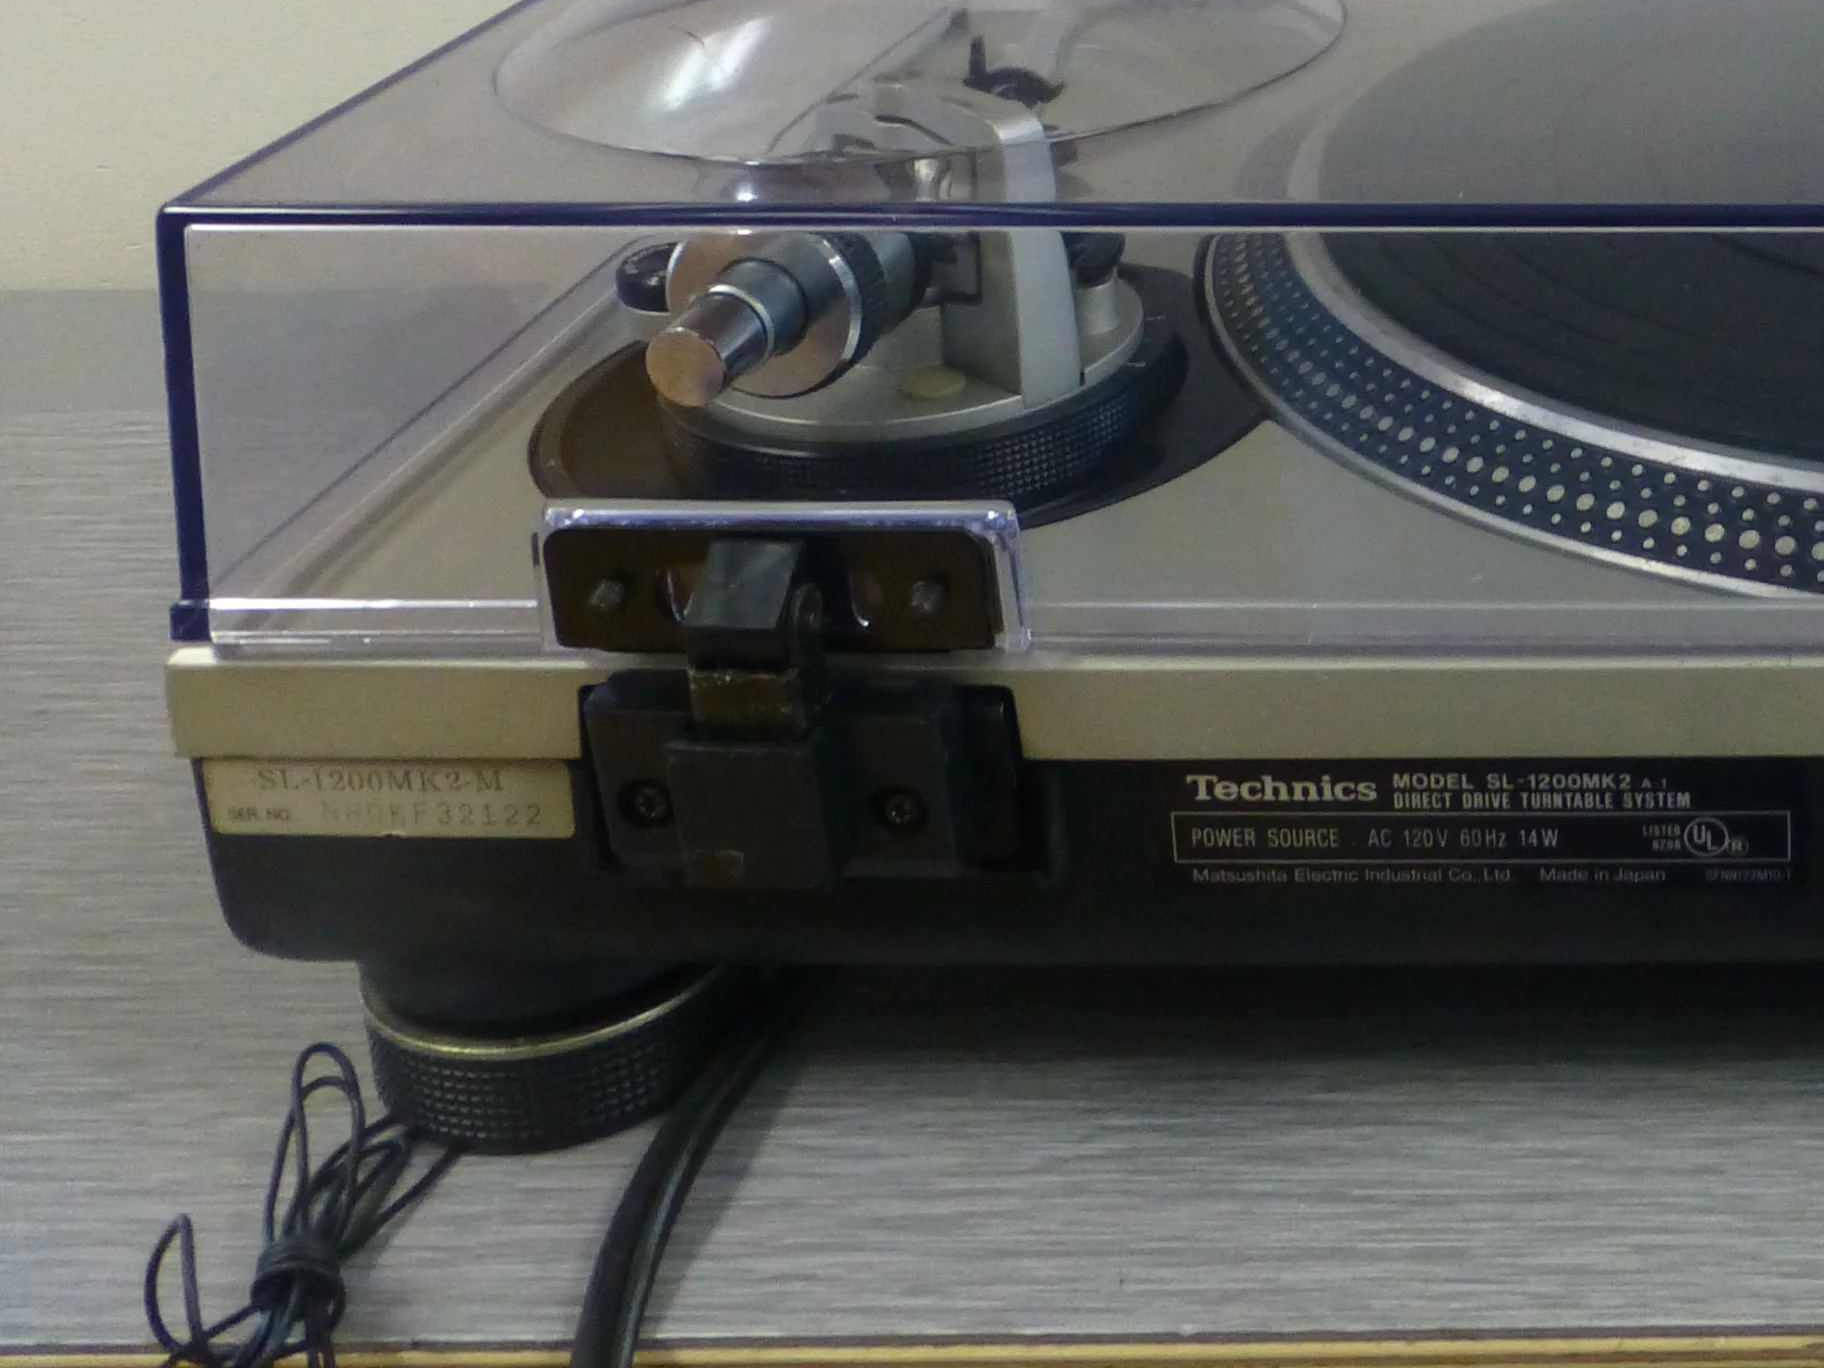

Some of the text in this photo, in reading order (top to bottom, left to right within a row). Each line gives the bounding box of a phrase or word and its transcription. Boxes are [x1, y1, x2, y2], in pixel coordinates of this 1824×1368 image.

[1186, 774, 1378, 802] Technics
[1392, 772, 1474, 790] MODEL
[1486, 772, 1632, 791] SL-1200MK2
[1393, 791, 1691, 810] DIRECT DRIVE TURNTABLE SYSTEM
[1190, 828, 1256, 848] POWER
[1267, 828, 1340, 848] SOURCE
[1367, 828, 1392, 848] AC
[1519, 828, 1559, 848] 14W
[1192, 867, 1288, 883] Matsushita
[1294, 867, 1360, 883] Electric
[1365, 867, 1443, 883] Industrial
[1539, 867, 1589, 882] Made
[1594, 867, 1611, 882] in
[1615, 867, 1667, 884] Japan
